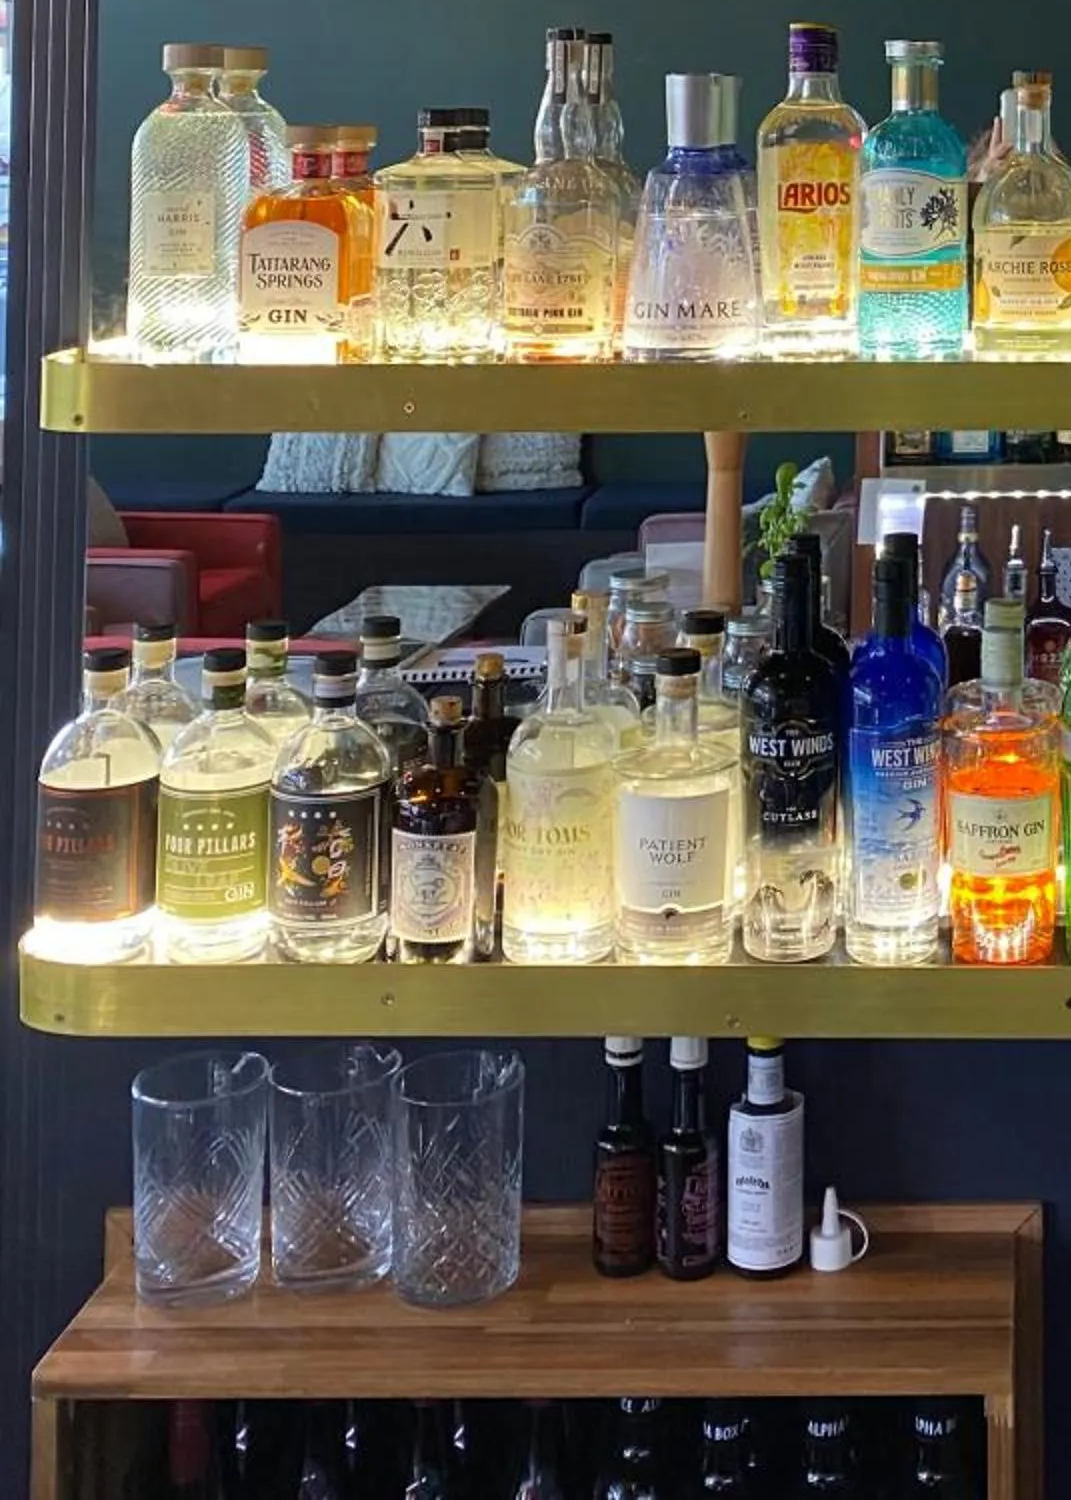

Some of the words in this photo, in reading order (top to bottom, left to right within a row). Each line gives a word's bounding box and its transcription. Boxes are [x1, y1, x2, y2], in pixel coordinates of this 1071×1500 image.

[778, 181, 850, 212] LARIOS
[248, 253, 331, 272] TATTARANG
[256, 273, 324, 290] SPRINGS
[267, 308, 309, 324] GIN
[634, 302, 669, 319] GIN
[677, 300, 742, 319] MARE
[749, 734, 787, 757] WEST
[791, 731, 834, 756] WINDS
[871, 748, 909, 768] WEST
[903, 779, 927, 789] GIN
[763, 809, 817, 822] CUTLASS
[536, 823, 591, 846] TOMS
[957, 819, 1020, 838] SAFFRON
[1024, 819, 1045, 836] GIN
[165, 834, 191, 855] FOUR
[198, 830, 256, 854] PILLARS
[639, 837, 706, 852] PATIENT
[649, 851, 696, 865] WOLF
